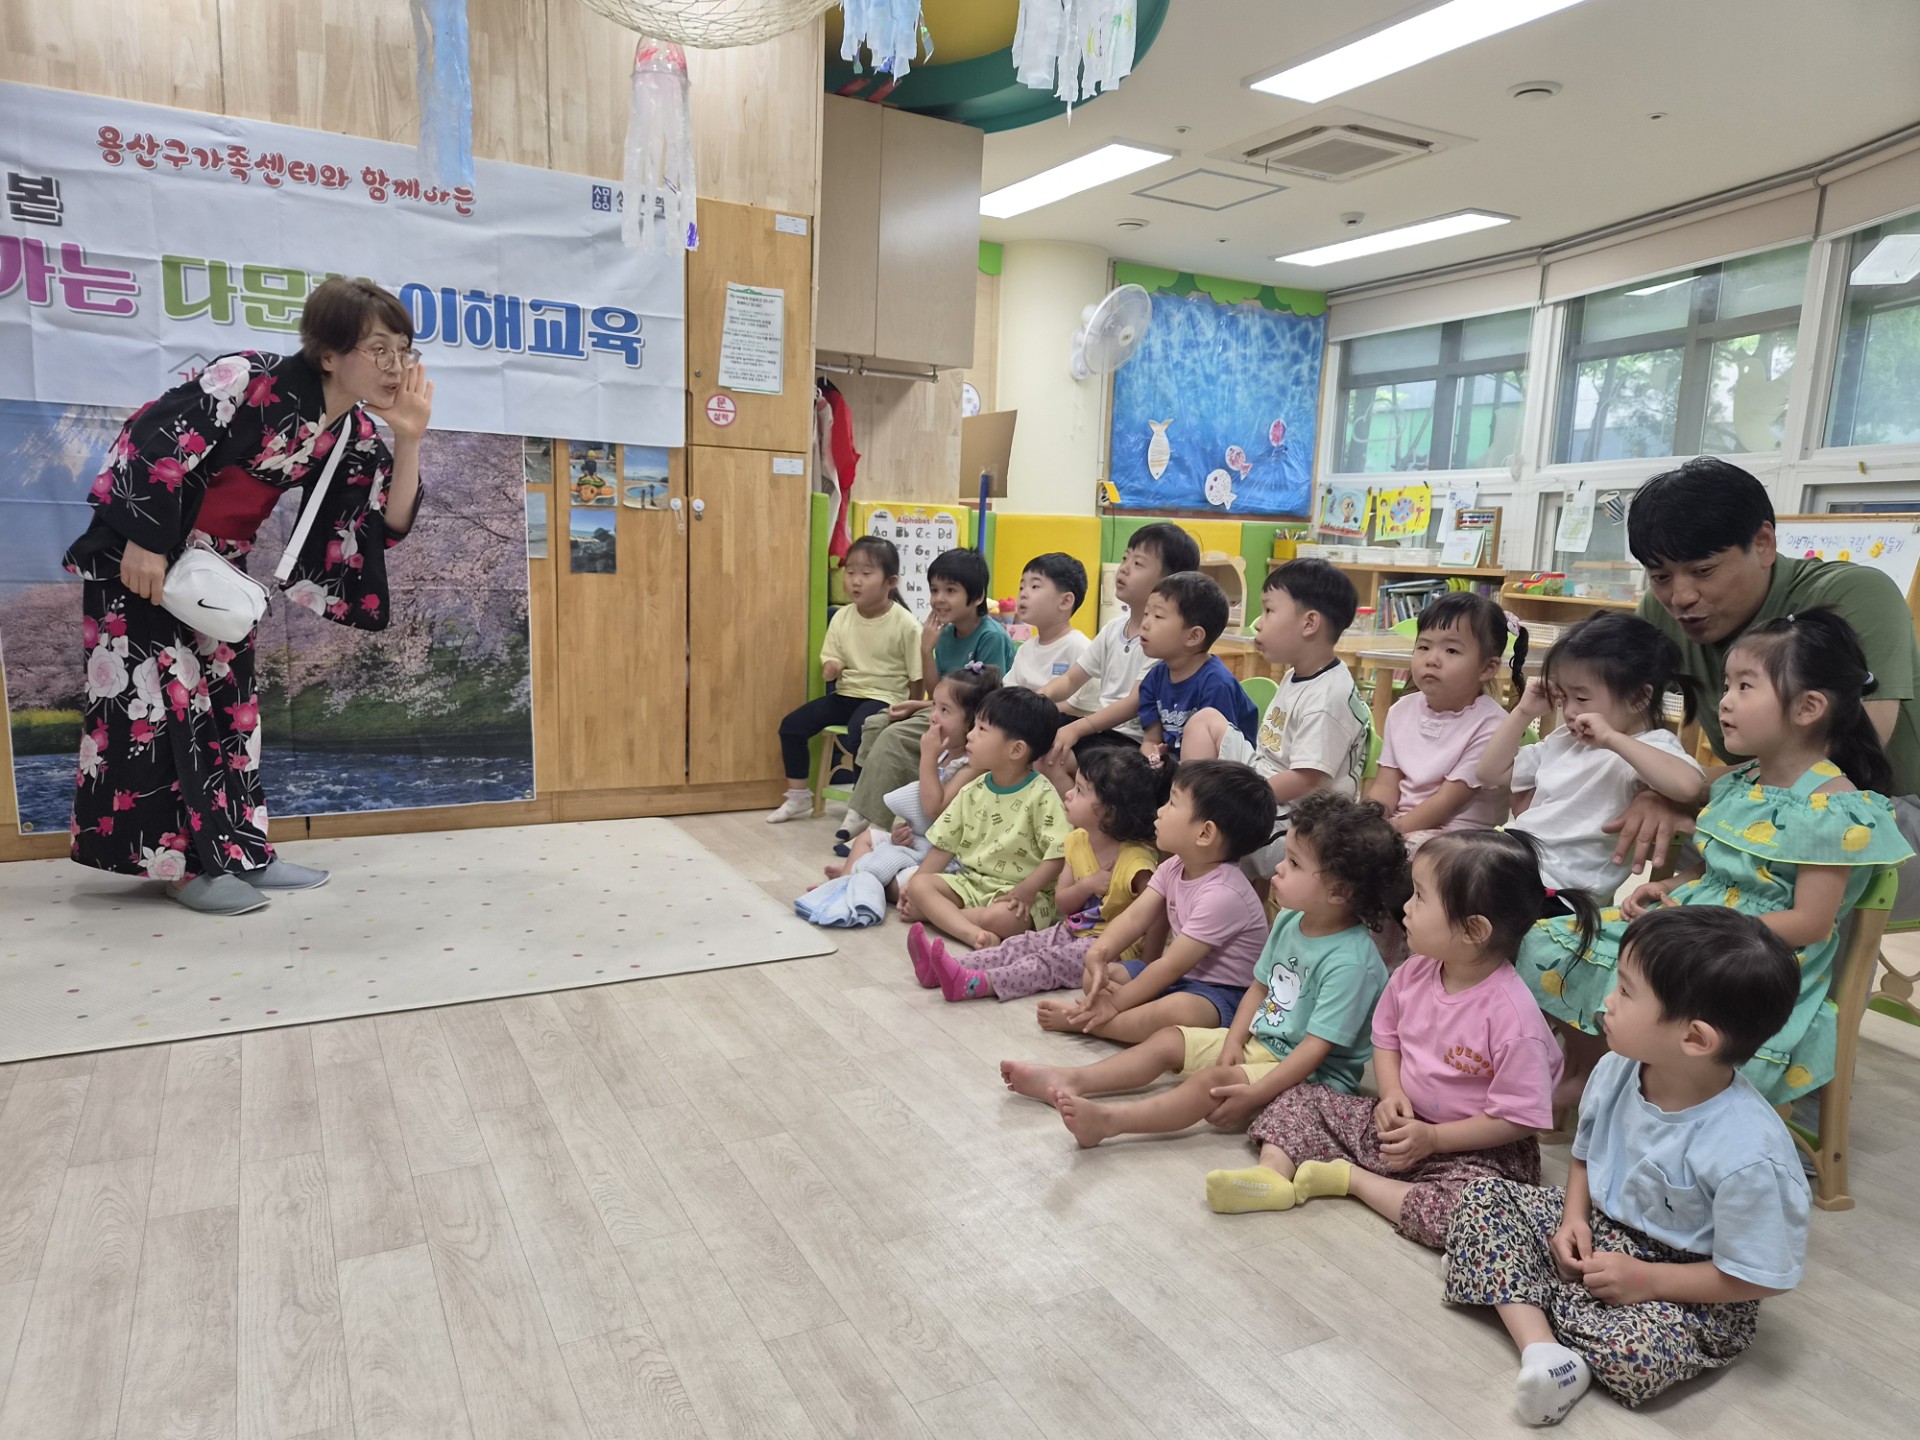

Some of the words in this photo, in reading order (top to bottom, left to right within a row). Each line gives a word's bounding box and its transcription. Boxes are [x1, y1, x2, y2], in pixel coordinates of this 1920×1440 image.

[96, 126, 350, 188] 용산구가족센터와
[161, 254, 375, 335] 다문
[398, 282, 645, 368] 이해교육
[896, 516, 930, 525] Alphabet
